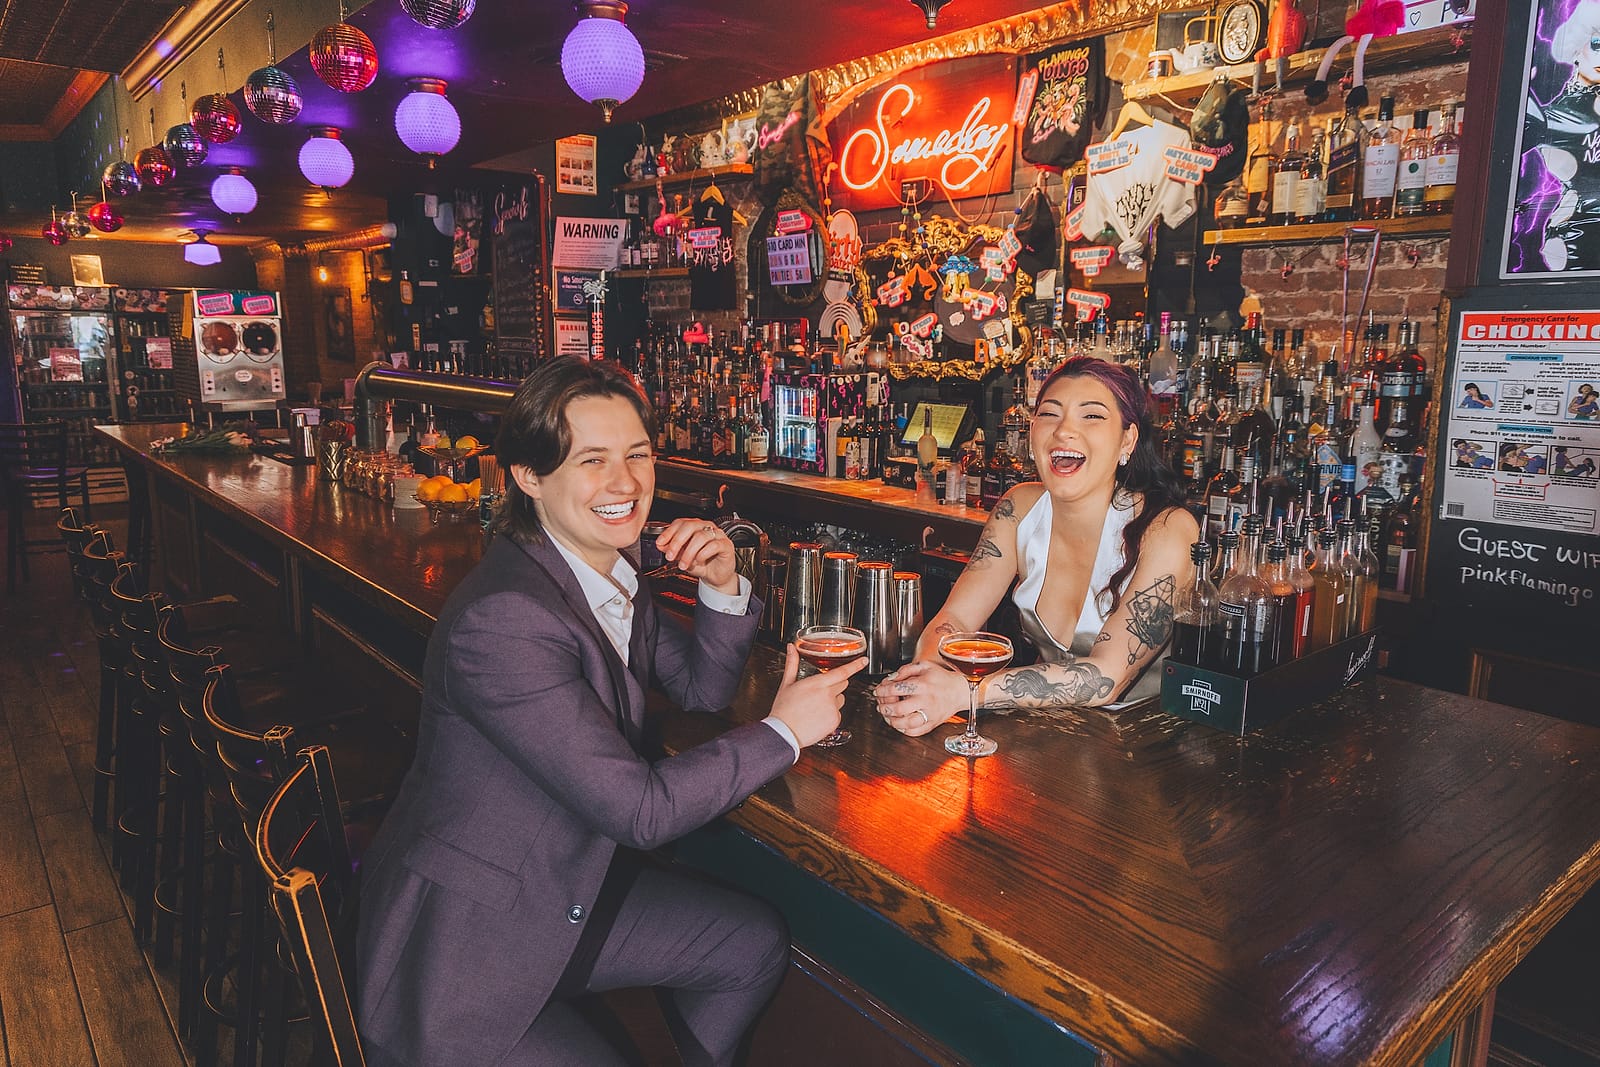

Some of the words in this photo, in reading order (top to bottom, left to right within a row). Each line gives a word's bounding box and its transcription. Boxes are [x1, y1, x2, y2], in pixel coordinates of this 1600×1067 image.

[1038, 47, 1090, 73] FLAMINGO
[1043, 58, 1090, 81] DINGO
[840, 84, 1009, 190] Someday
[1088, 145, 1112, 156] METAL
[1165, 148, 1192, 162] METAL
[1194, 155, 1213, 167] LOGO
[1168, 166, 1185, 177] HAT
[563, 222, 619, 239] WARNING
[778, 239, 794, 250] CARD
[795, 237, 806, 249] MIN
[1073, 249, 1110, 259] FLAMINGO
[770, 269, 794, 283] PARTIES
[1070, 292, 1105, 306] FLAMINGO
[1501, 316, 1545, 324] Emergency
[1458, 527, 1547, 562] GUEST
[1185, 686, 1217, 701] SMIRNOFF
